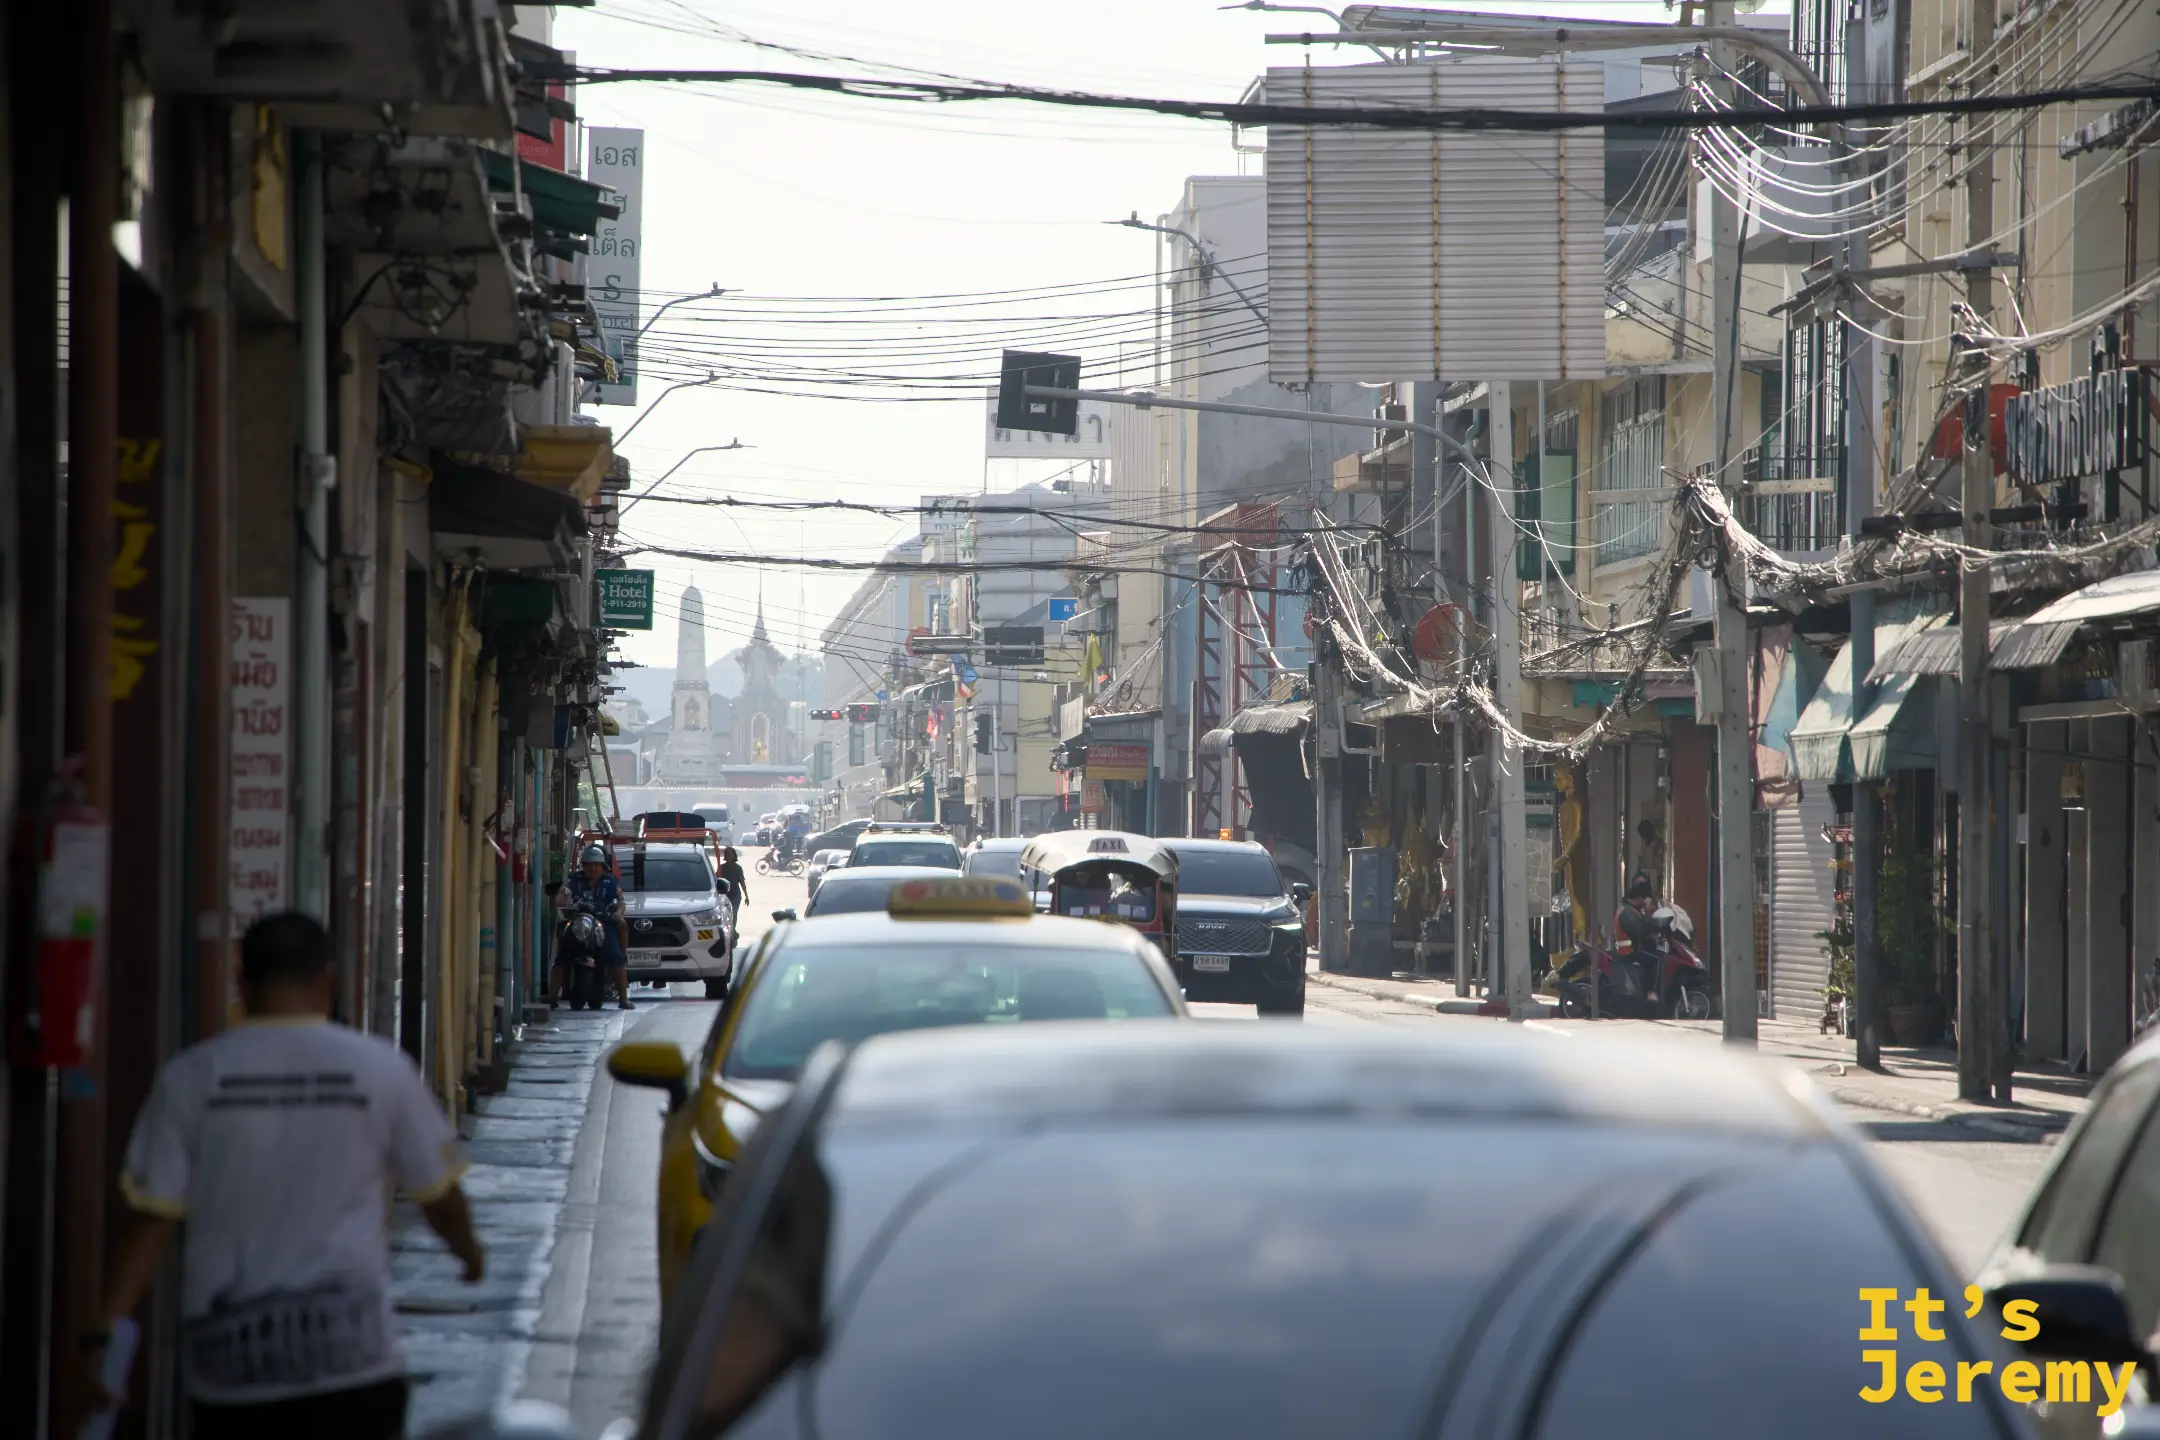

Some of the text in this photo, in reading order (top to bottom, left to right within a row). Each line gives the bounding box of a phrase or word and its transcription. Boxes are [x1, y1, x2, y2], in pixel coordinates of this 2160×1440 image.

[595, 146, 637, 166] เอส
[593, 227, 635, 258] เต็ล
[604, 274, 621, 301] S
[599, 313, 634, 329] otel
[608, 585, 647, 599] Hotel
[603, 600, 647, 609] 1-911-2919
[1096, 840, 1121, 851] TAXI
